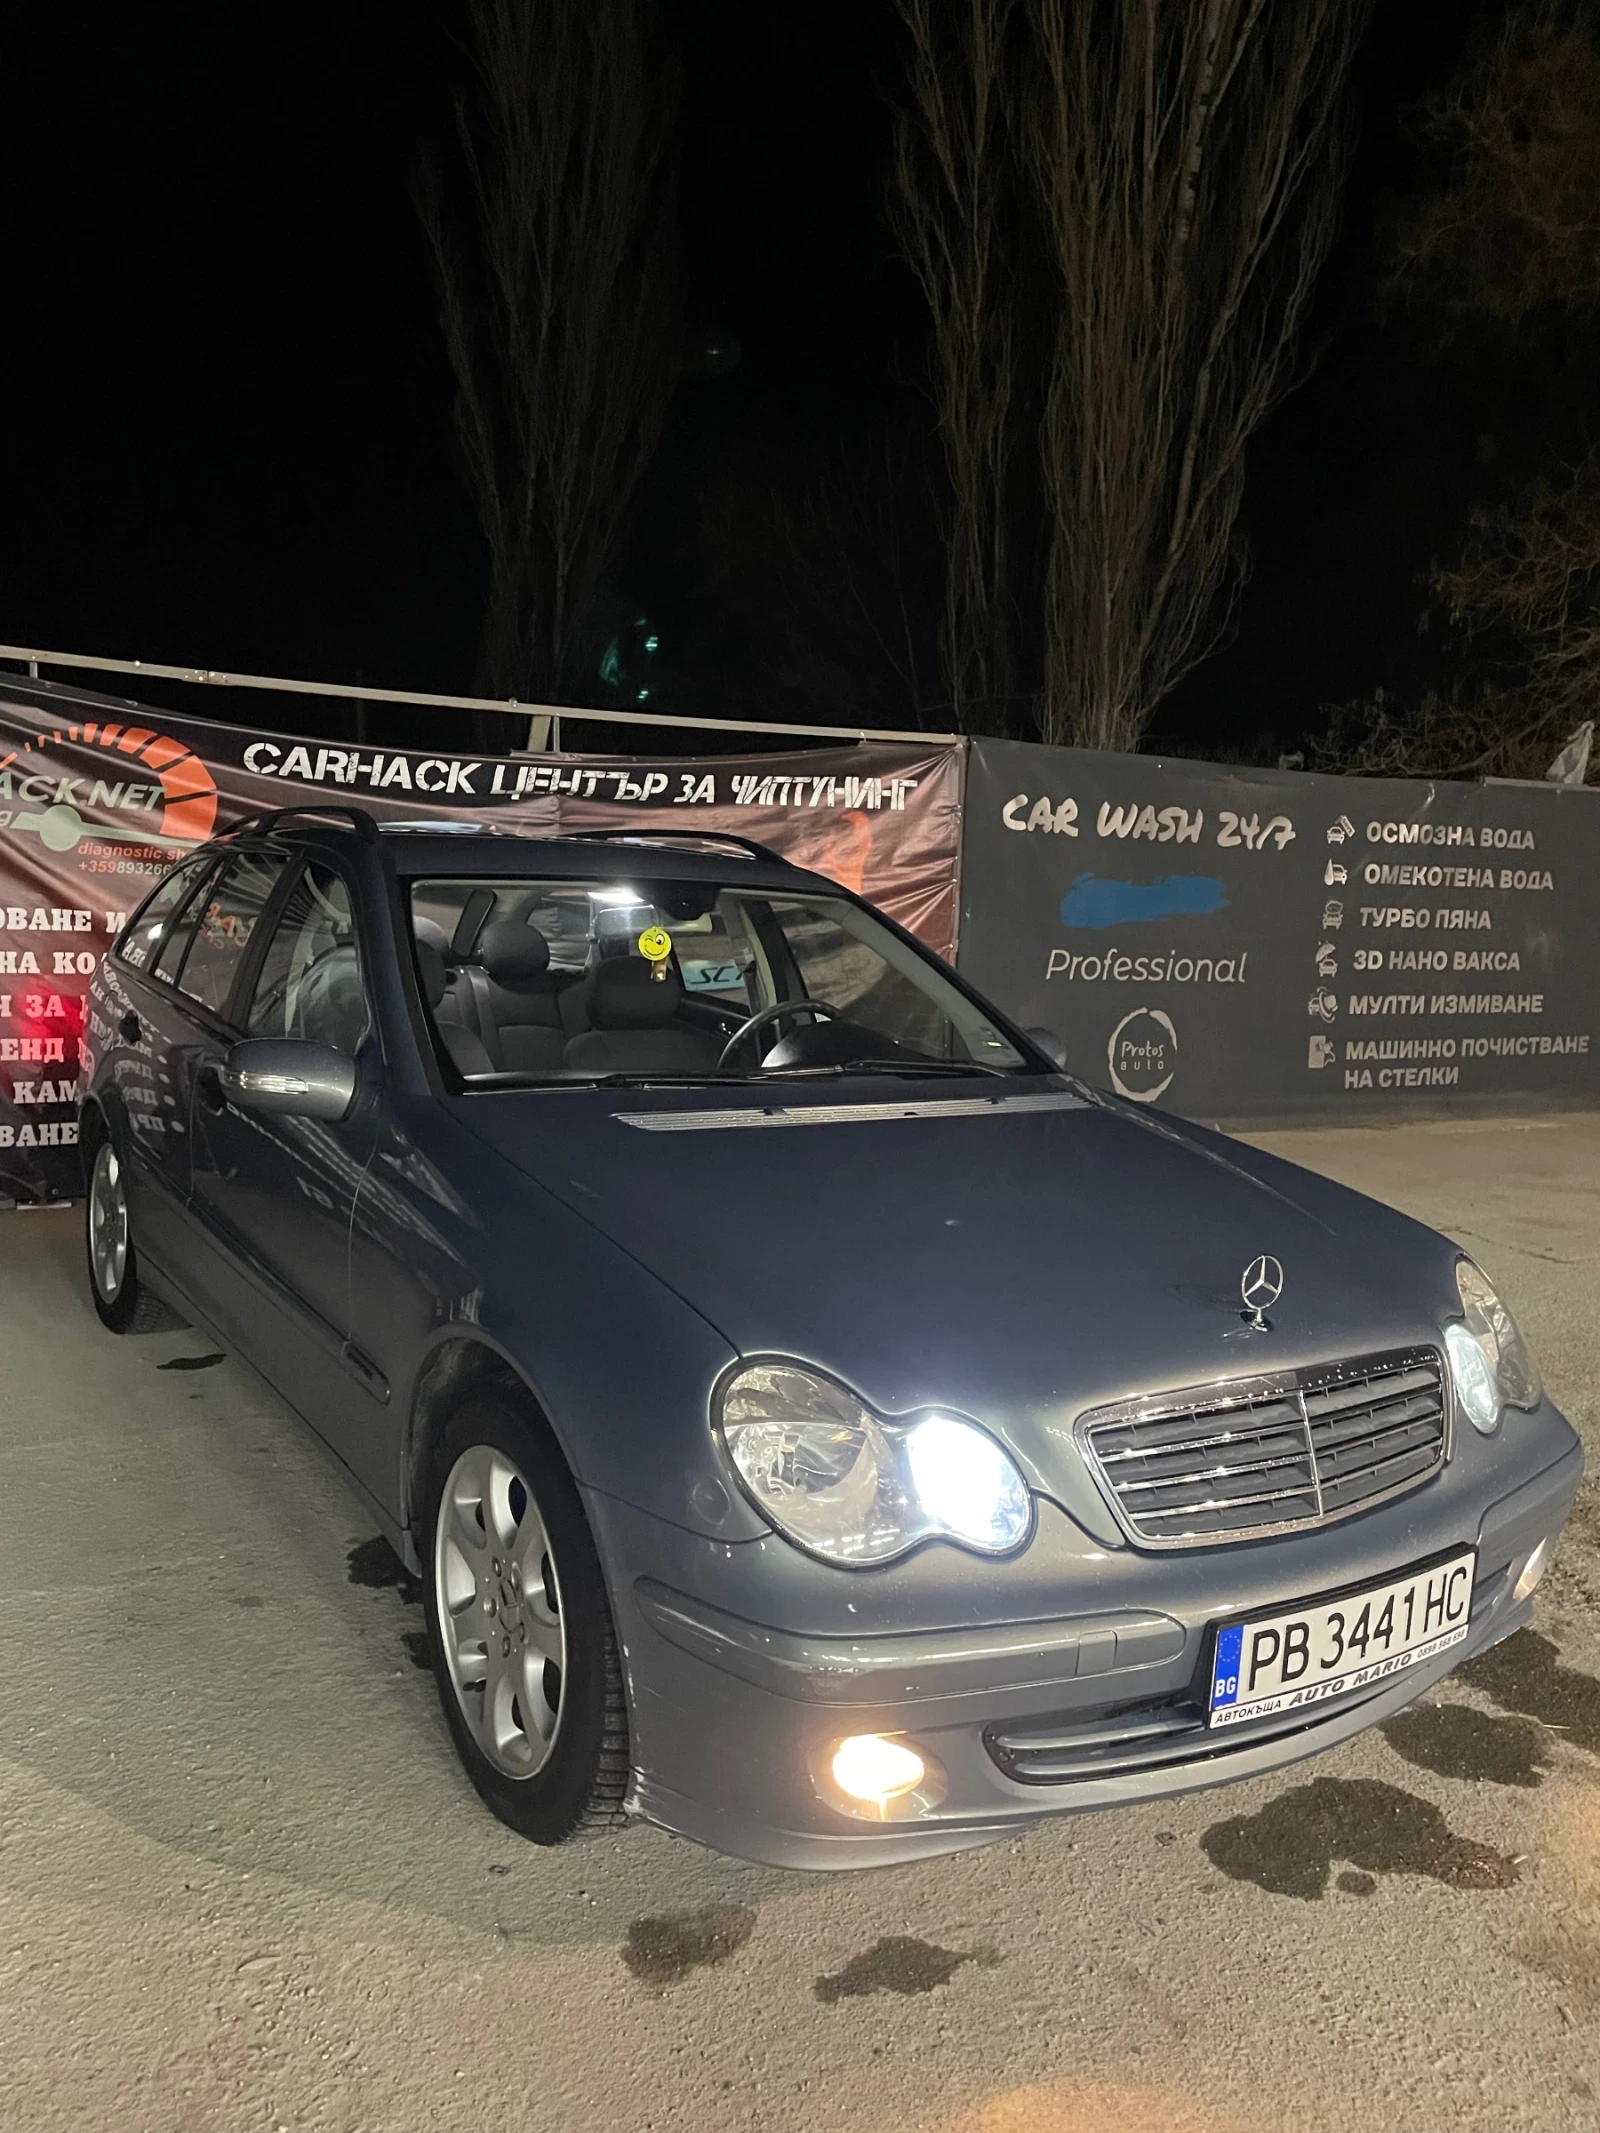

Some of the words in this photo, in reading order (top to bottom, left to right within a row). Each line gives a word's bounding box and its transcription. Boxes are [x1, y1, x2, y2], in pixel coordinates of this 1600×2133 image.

[243, 743, 482, 795] CARHACK
[490, 764, 669, 802] ЦЕНТЪР
[673, 774, 715, 803] ЗА
[731, 775, 918, 810] ЧИПТУНИНГ
[1002, 794, 1079, 838] CAR
[1096, 801, 1203, 843] WASH
[1217, 811, 1296, 851] 24/7
[1366, 821, 1475, 847] ОСМОЗНА
[1480, 827, 1535, 850] ВОДА
[78, 842, 162, 859] diagnostic
[1364, 863, 1494, 888] ОМЕКОТЕНА
[1500, 869, 1554, 890] ВОДА
[1359, 907, 1430, 928] ТУРБО
[1435, 909, 1492, 930] ПЯНА
[53, 951, 107, 974] КО
[1046, 948, 1247, 983] Professional
[1353, 950, 1383, 971] 3D
[1388, 951, 1448, 971] НАНО
[1452, 951, 1521, 971] ВАКСА
[26, 994, 65, 1017] ЗА
[1349, 995, 1425, 1015] МУЛТИ
[1430, 995, 1544, 1015] ИЗМИВАНЕ
[1121, 1041, 1164, 1058] Protos
[1346, 1038, 1456, 1060] МАШИННО
[1461, 1035, 1590, 1057] ПОЧИСТВАНЕ
[1344, 1070, 1373, 1088] НА
[1378, 1066, 1459, 1088] СТЕЛКИ
[1248, 1621, 1310, 1691] PB
[1320, 1586, 1416, 1669] 3441
[1423, 1566, 1467, 1633] HC
[1214, 1675, 1237, 1698] BG
[1215, 1700, 1281, 1724] АВТОКЪЩА
[1289, 1679, 1344, 1706] AUTO
[1353, 1653, 1412, 1684] MARIO
